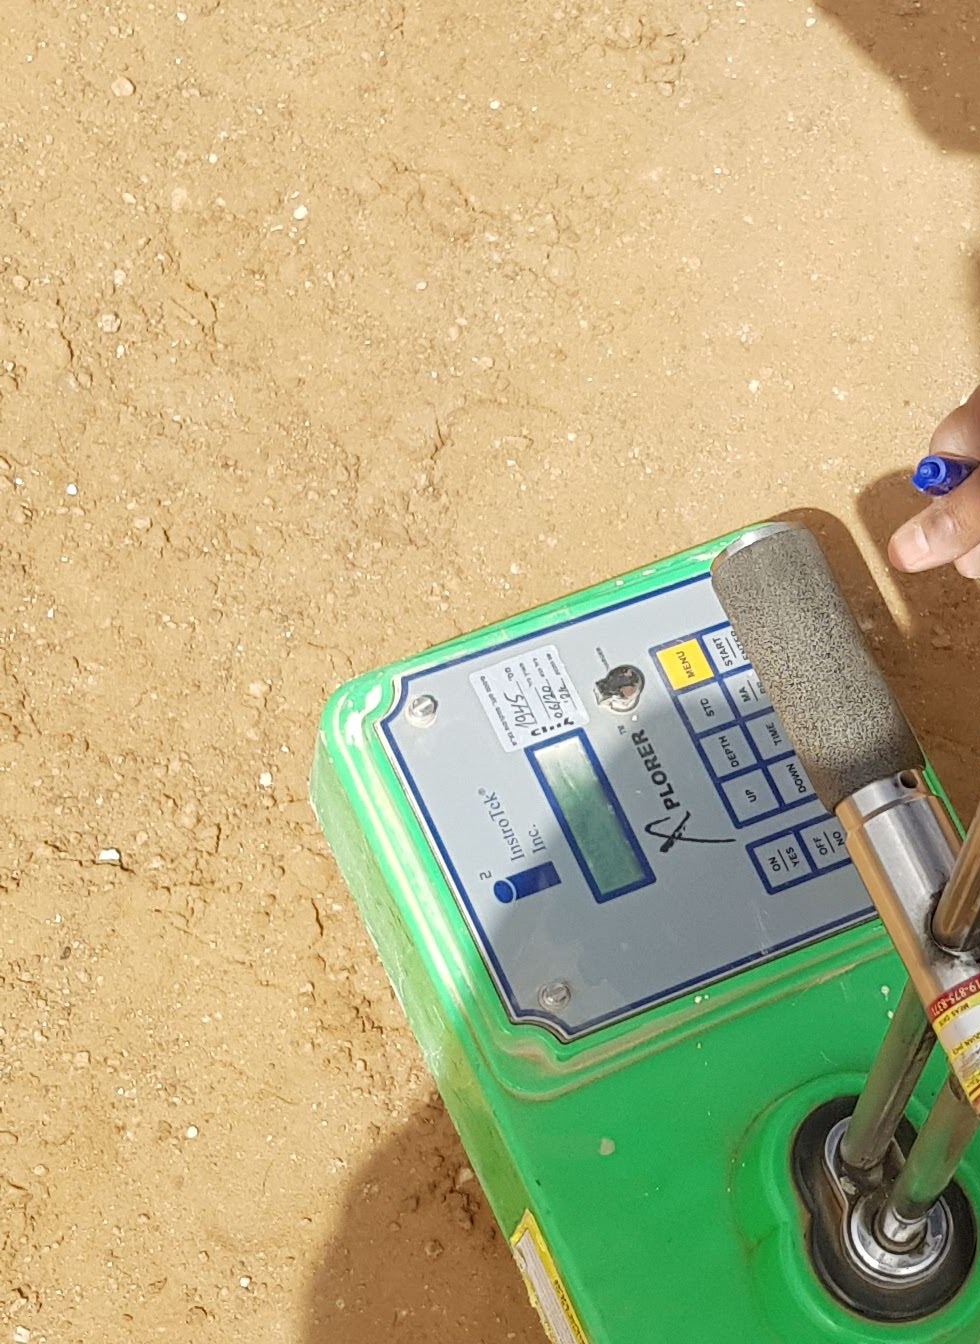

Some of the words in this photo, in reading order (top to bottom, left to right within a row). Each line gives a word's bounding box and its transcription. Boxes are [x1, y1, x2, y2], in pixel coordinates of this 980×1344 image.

[676, 650, 695, 678] MENU
[712, 637, 733, 667] START
[503, 692, 537, 728] 1945
[765, 722, 783, 746] TIME
[718, 735, 740, 768] DEPTH
[786, 763, 807, 794] DOWN
[745, 789, 757, 803] UP
[528, 824, 547, 854] Inc.
[812, 837, 828, 856] OFF
[832, 831, 845, 847] NO
[768, 857, 781, 872] ON
[785, 846, 800, 867] YES
